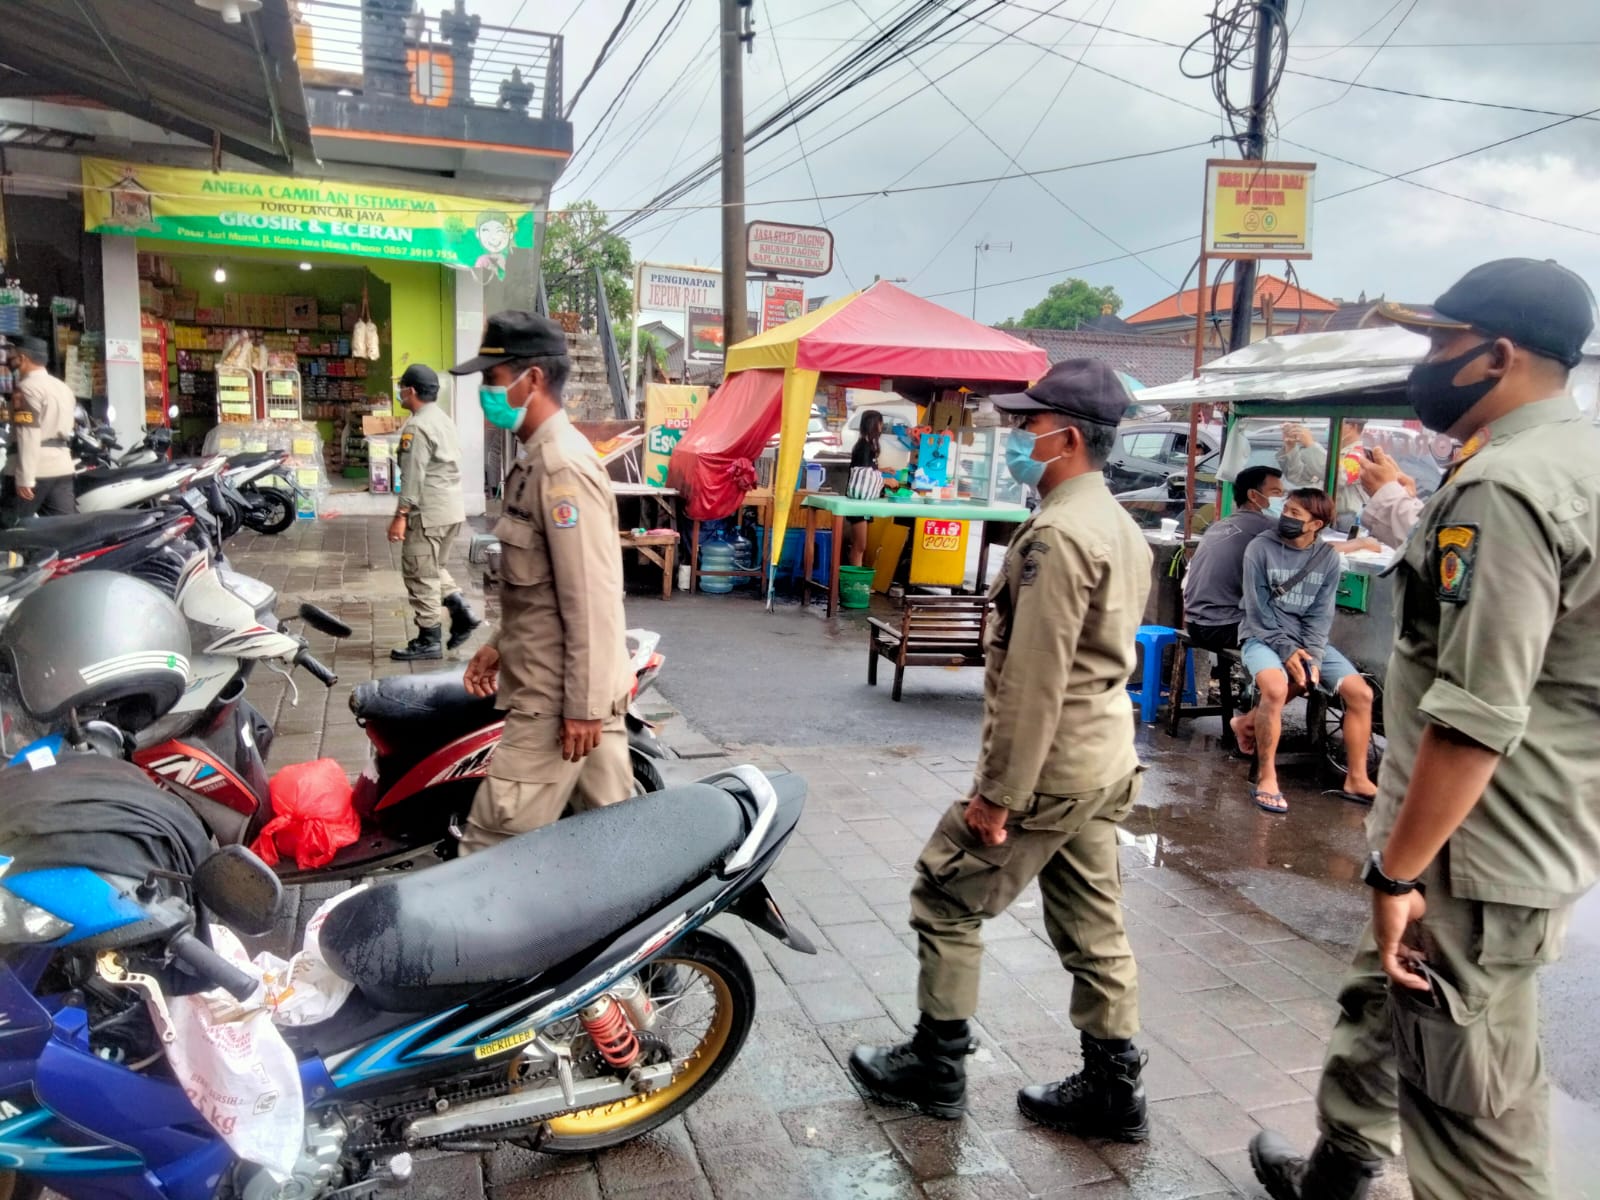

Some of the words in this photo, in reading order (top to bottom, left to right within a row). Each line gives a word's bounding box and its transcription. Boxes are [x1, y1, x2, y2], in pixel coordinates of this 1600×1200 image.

[202, 179, 263, 197] ANEKA
[269, 185, 349, 205] CAMILAN
[354, 194, 437, 213] ISTIMEWA
[261, 201, 297, 214] TOKO
[301, 205, 353, 219] LANCAR
[357, 210, 385, 222] JAYA
[219, 211, 304, 232] GROSIR
[308, 218, 326, 235] &
[331, 221, 413, 243] ECERAN
[797, 233, 825, 248] DAGING
[792, 246, 821, 259] DAGING
[775, 256, 796, 266] AYAM
[804, 258, 825, 269] IKAN
[650, 273, 716, 289] PENGINAPAN
[648, 284, 681, 308] JEPUN
[926, 526, 947, 536] TEA
[924, 535, 959, 549] POCI
[480, 1031, 531, 1057] ROCKILLER
[210, 1105, 239, 1136] kg
